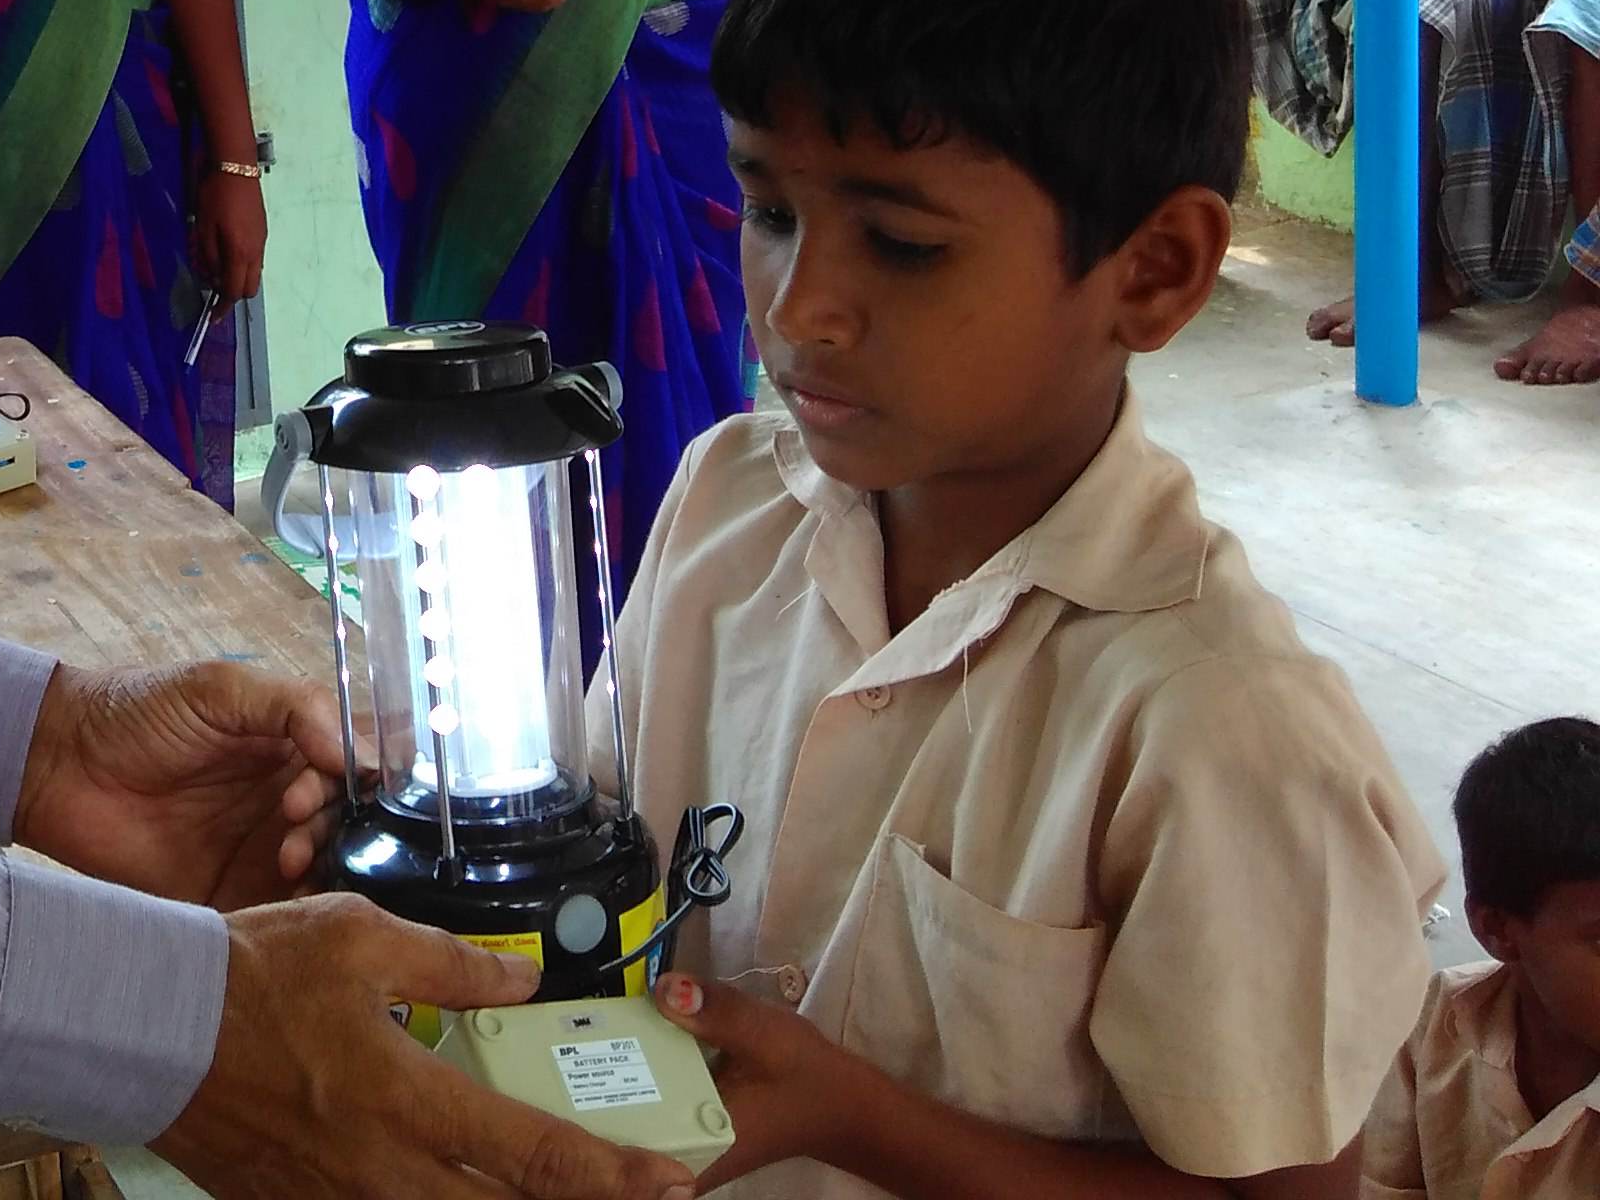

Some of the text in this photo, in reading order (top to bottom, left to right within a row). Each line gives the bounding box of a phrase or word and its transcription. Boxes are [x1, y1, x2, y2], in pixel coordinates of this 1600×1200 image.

[559, 1046, 579, 1056] BPL
[573, 1055, 629, 1068] BATTERY PACK
[567, 1072, 590, 1081] Power
